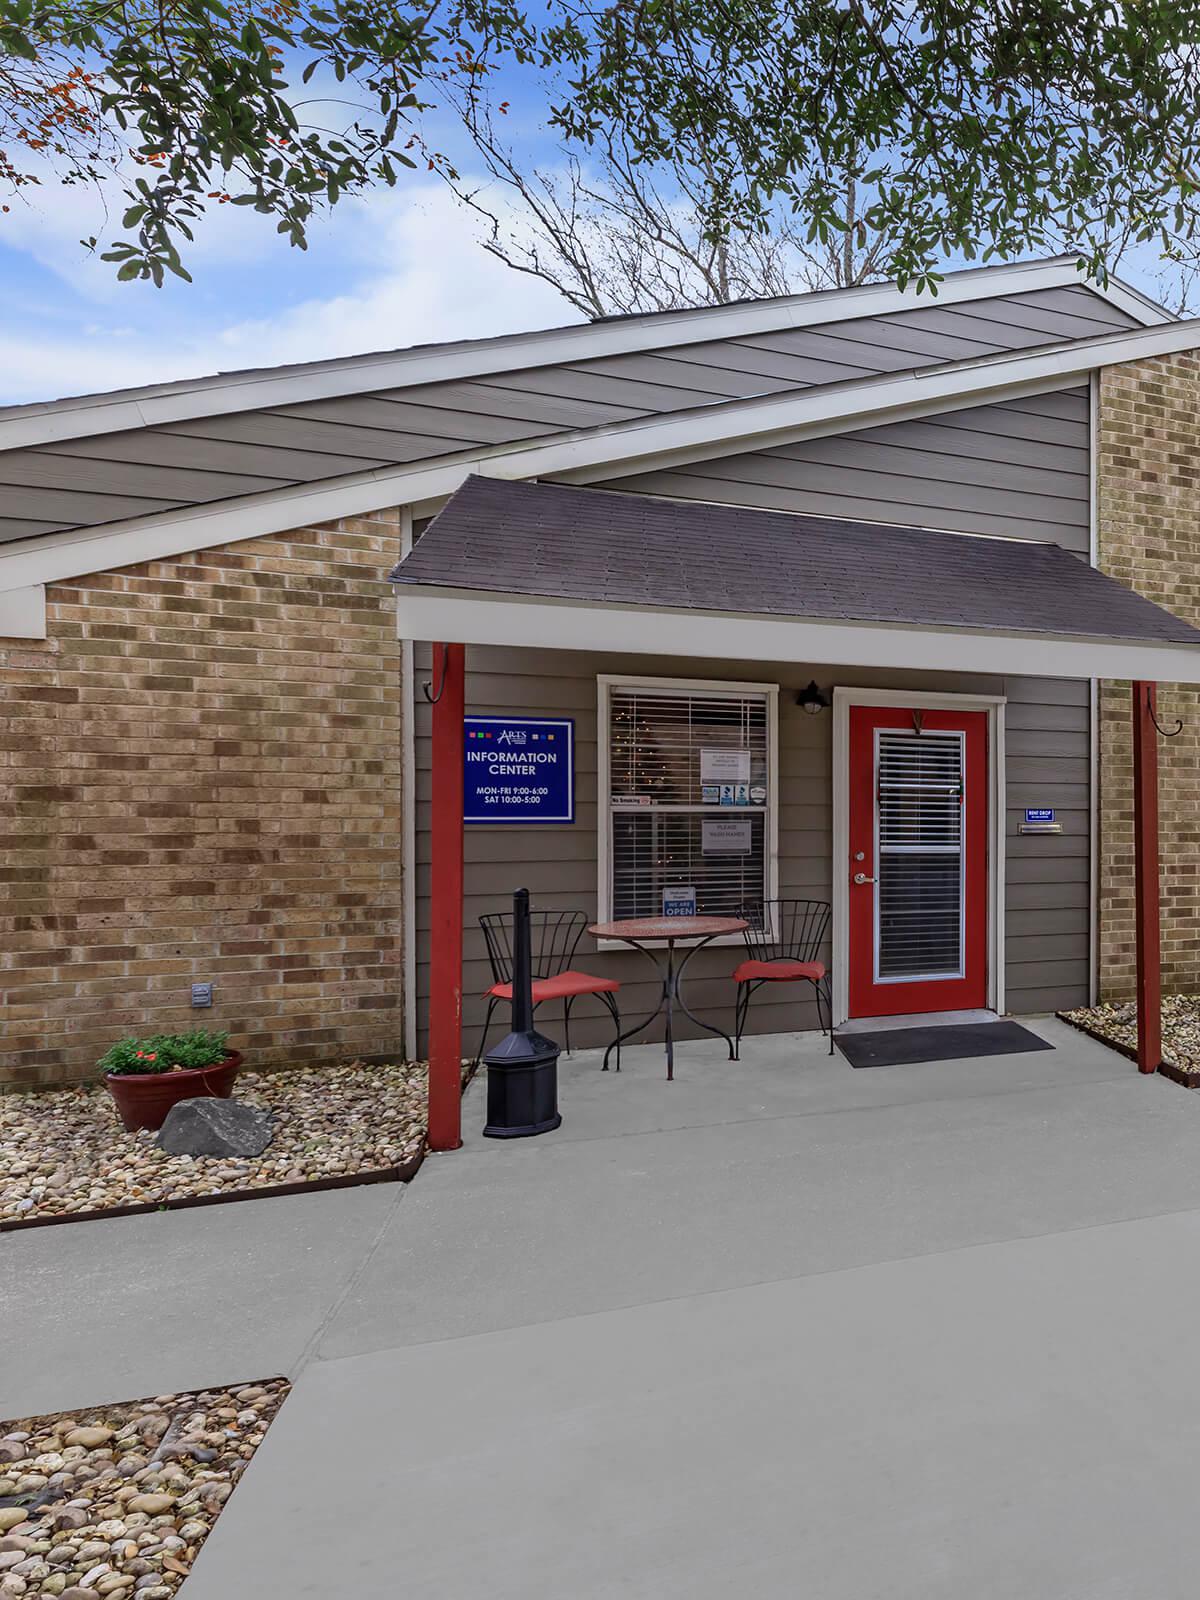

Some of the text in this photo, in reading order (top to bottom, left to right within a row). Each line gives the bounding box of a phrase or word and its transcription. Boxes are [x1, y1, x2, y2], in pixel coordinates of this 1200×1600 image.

[467, 751, 557, 763] INFORMATION
[488, 764, 536, 775] CENTER
[476, 787, 548, 795] MON-FRI 9:00-6:00
[501, 796, 541, 804] 10:00-5:00
[666, 907, 693, 916] OPEN
